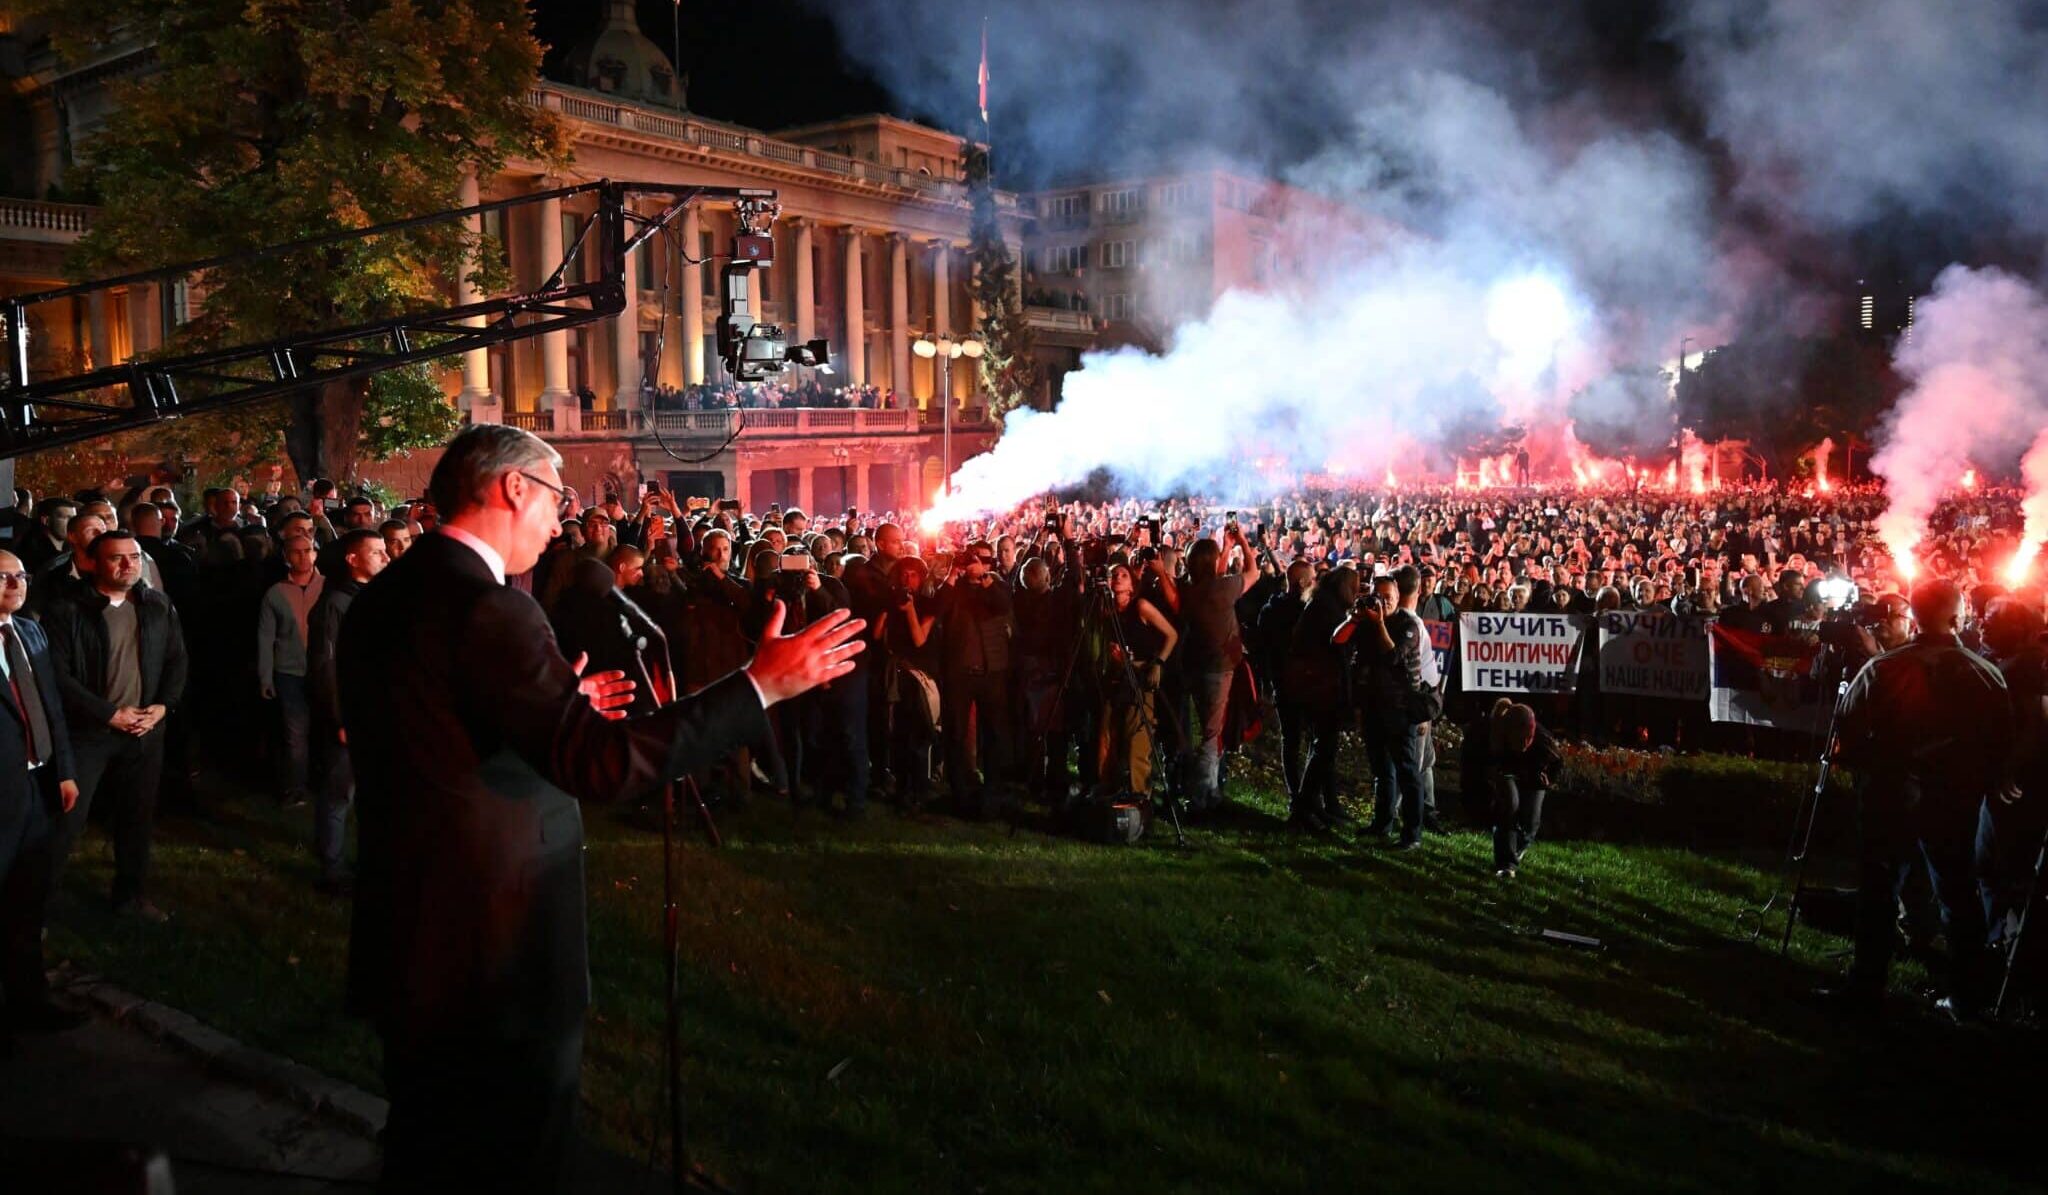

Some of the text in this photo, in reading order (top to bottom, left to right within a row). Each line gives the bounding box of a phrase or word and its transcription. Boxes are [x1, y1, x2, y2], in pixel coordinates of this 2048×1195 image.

[1478, 616, 1566, 637] ВУЧИЋ
[1467, 641, 1578, 665] ПОЛИТИЧКИ
[1633, 641, 1685, 666] ОЧЕ
[1477, 668, 1568, 689] ГЕНИЈЕ
[1605, 665, 1649, 689] НАШЕ
